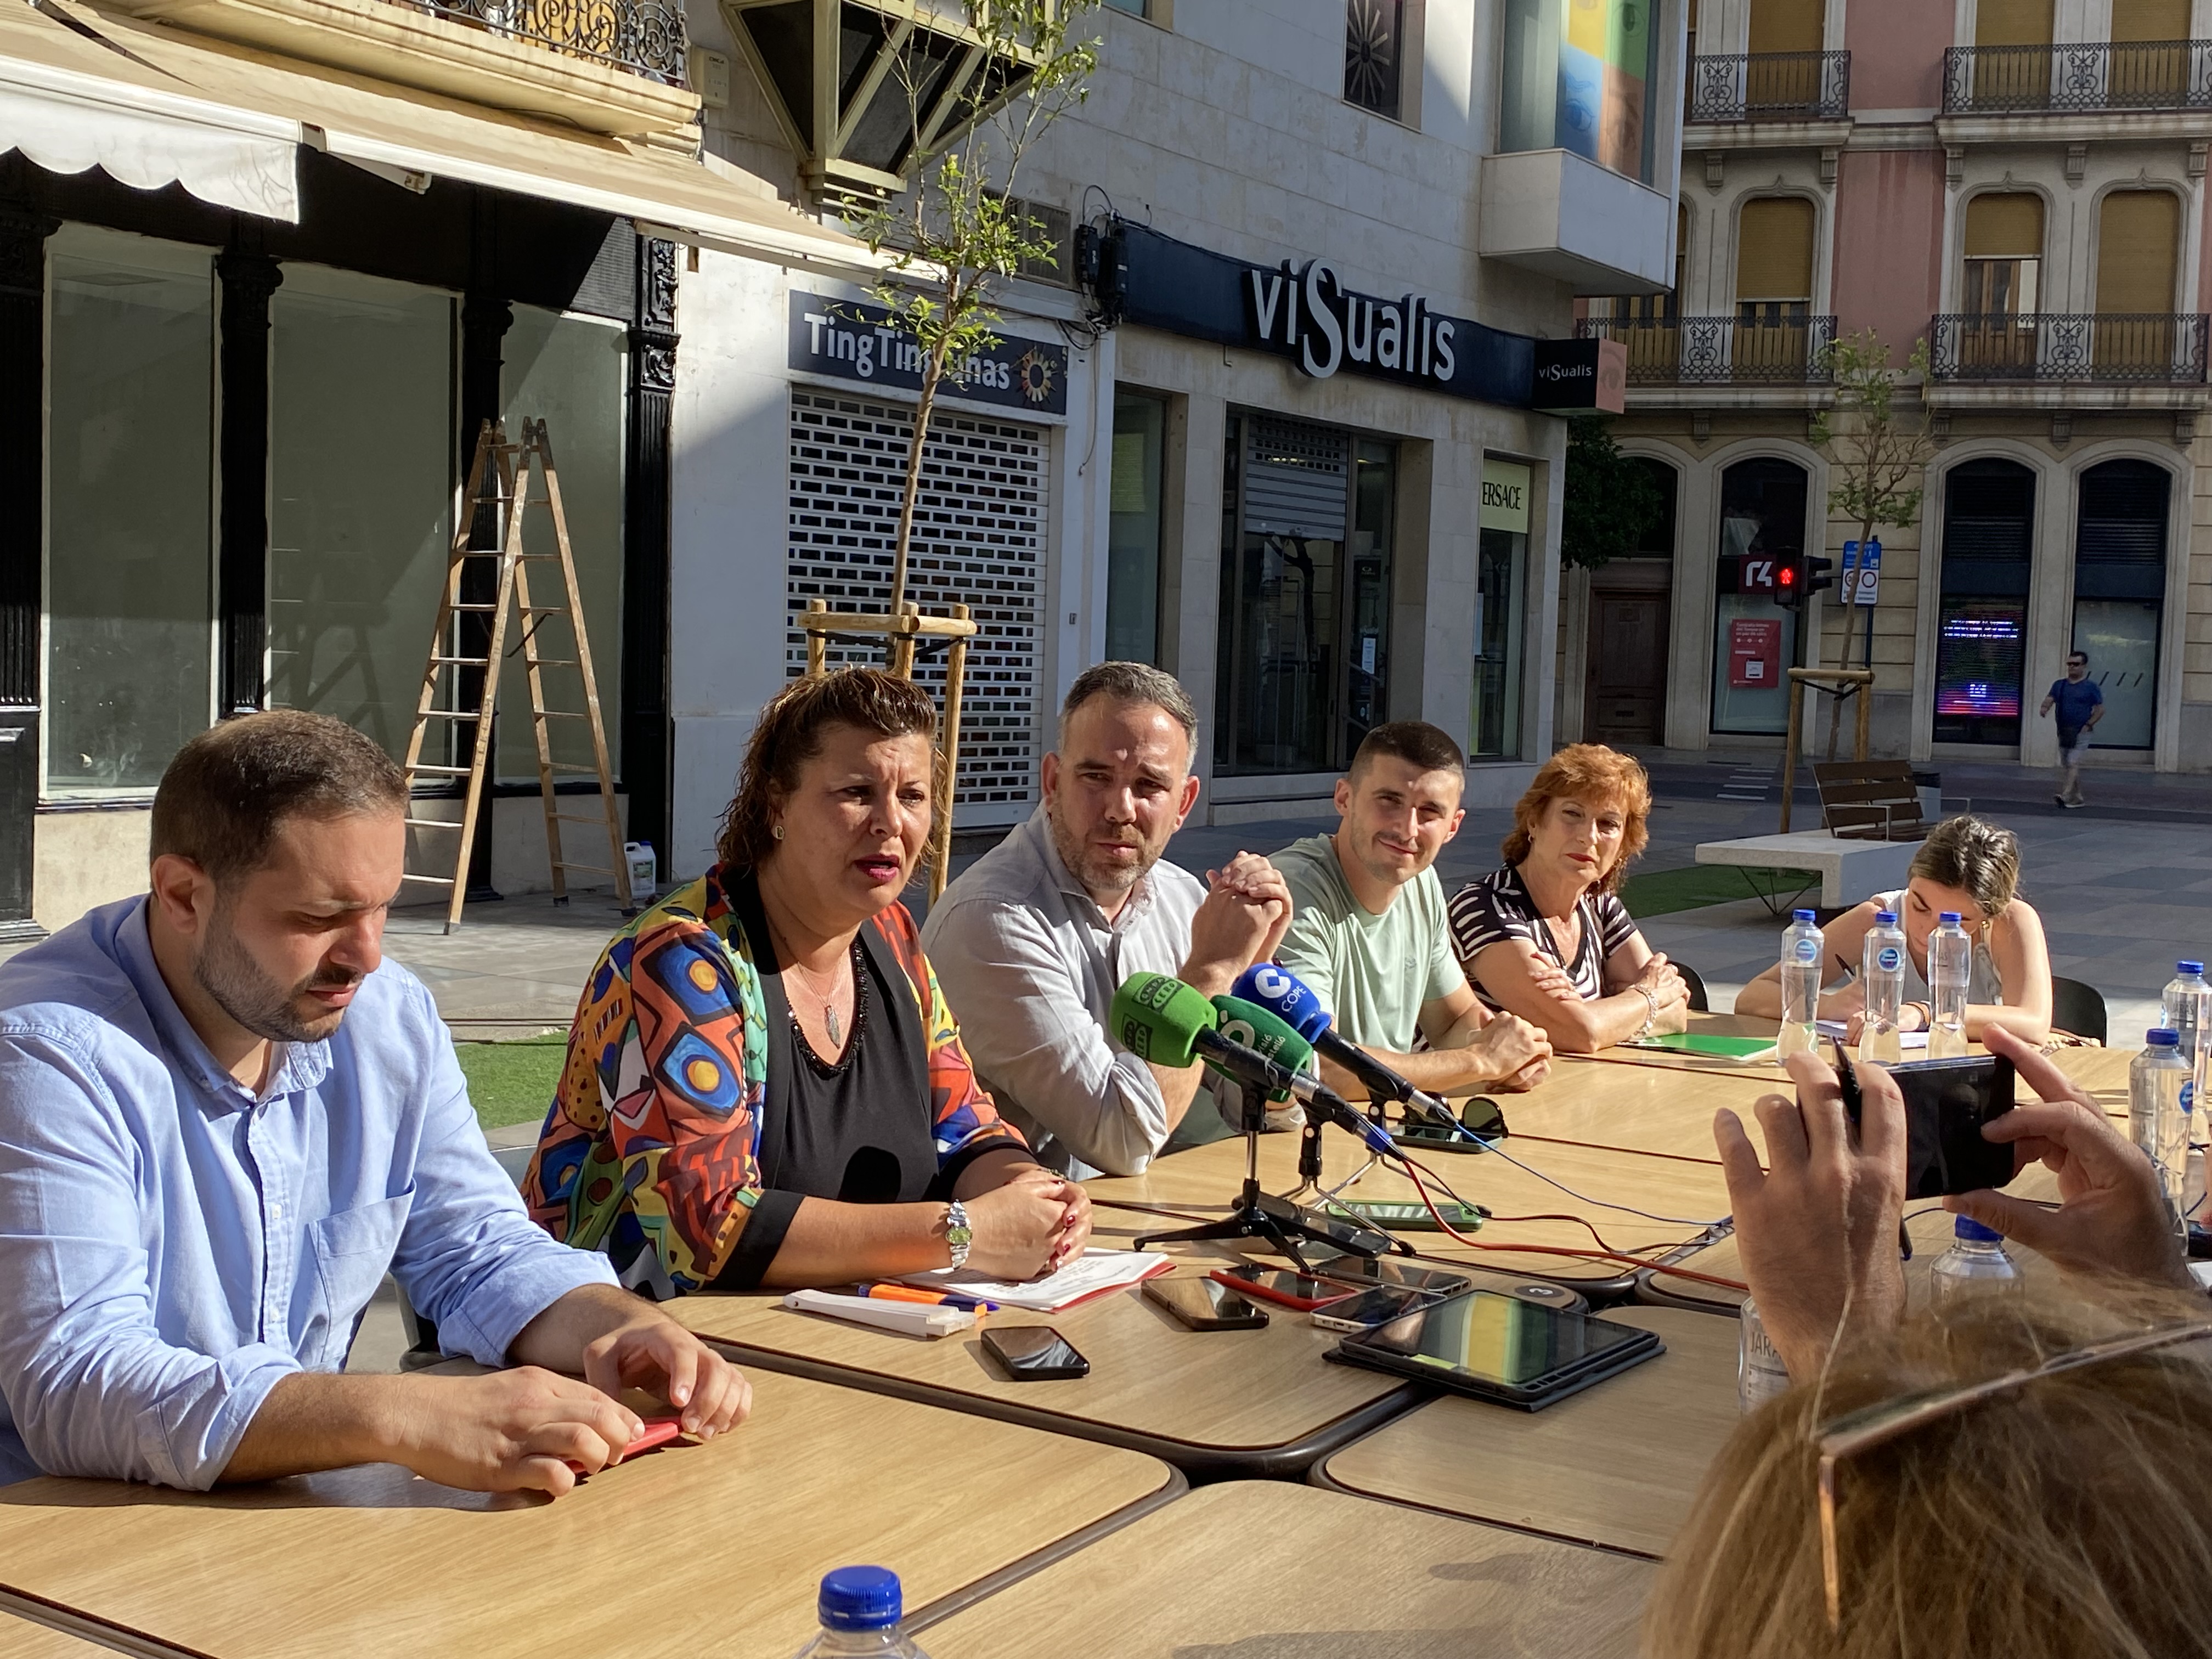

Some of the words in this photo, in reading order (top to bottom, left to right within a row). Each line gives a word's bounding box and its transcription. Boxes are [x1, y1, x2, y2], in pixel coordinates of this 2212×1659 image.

[1251, 258, 1455, 381] viSualis
[1538, 364, 1592, 381] viSualis
[1281, 985, 1307, 1012] COPE
